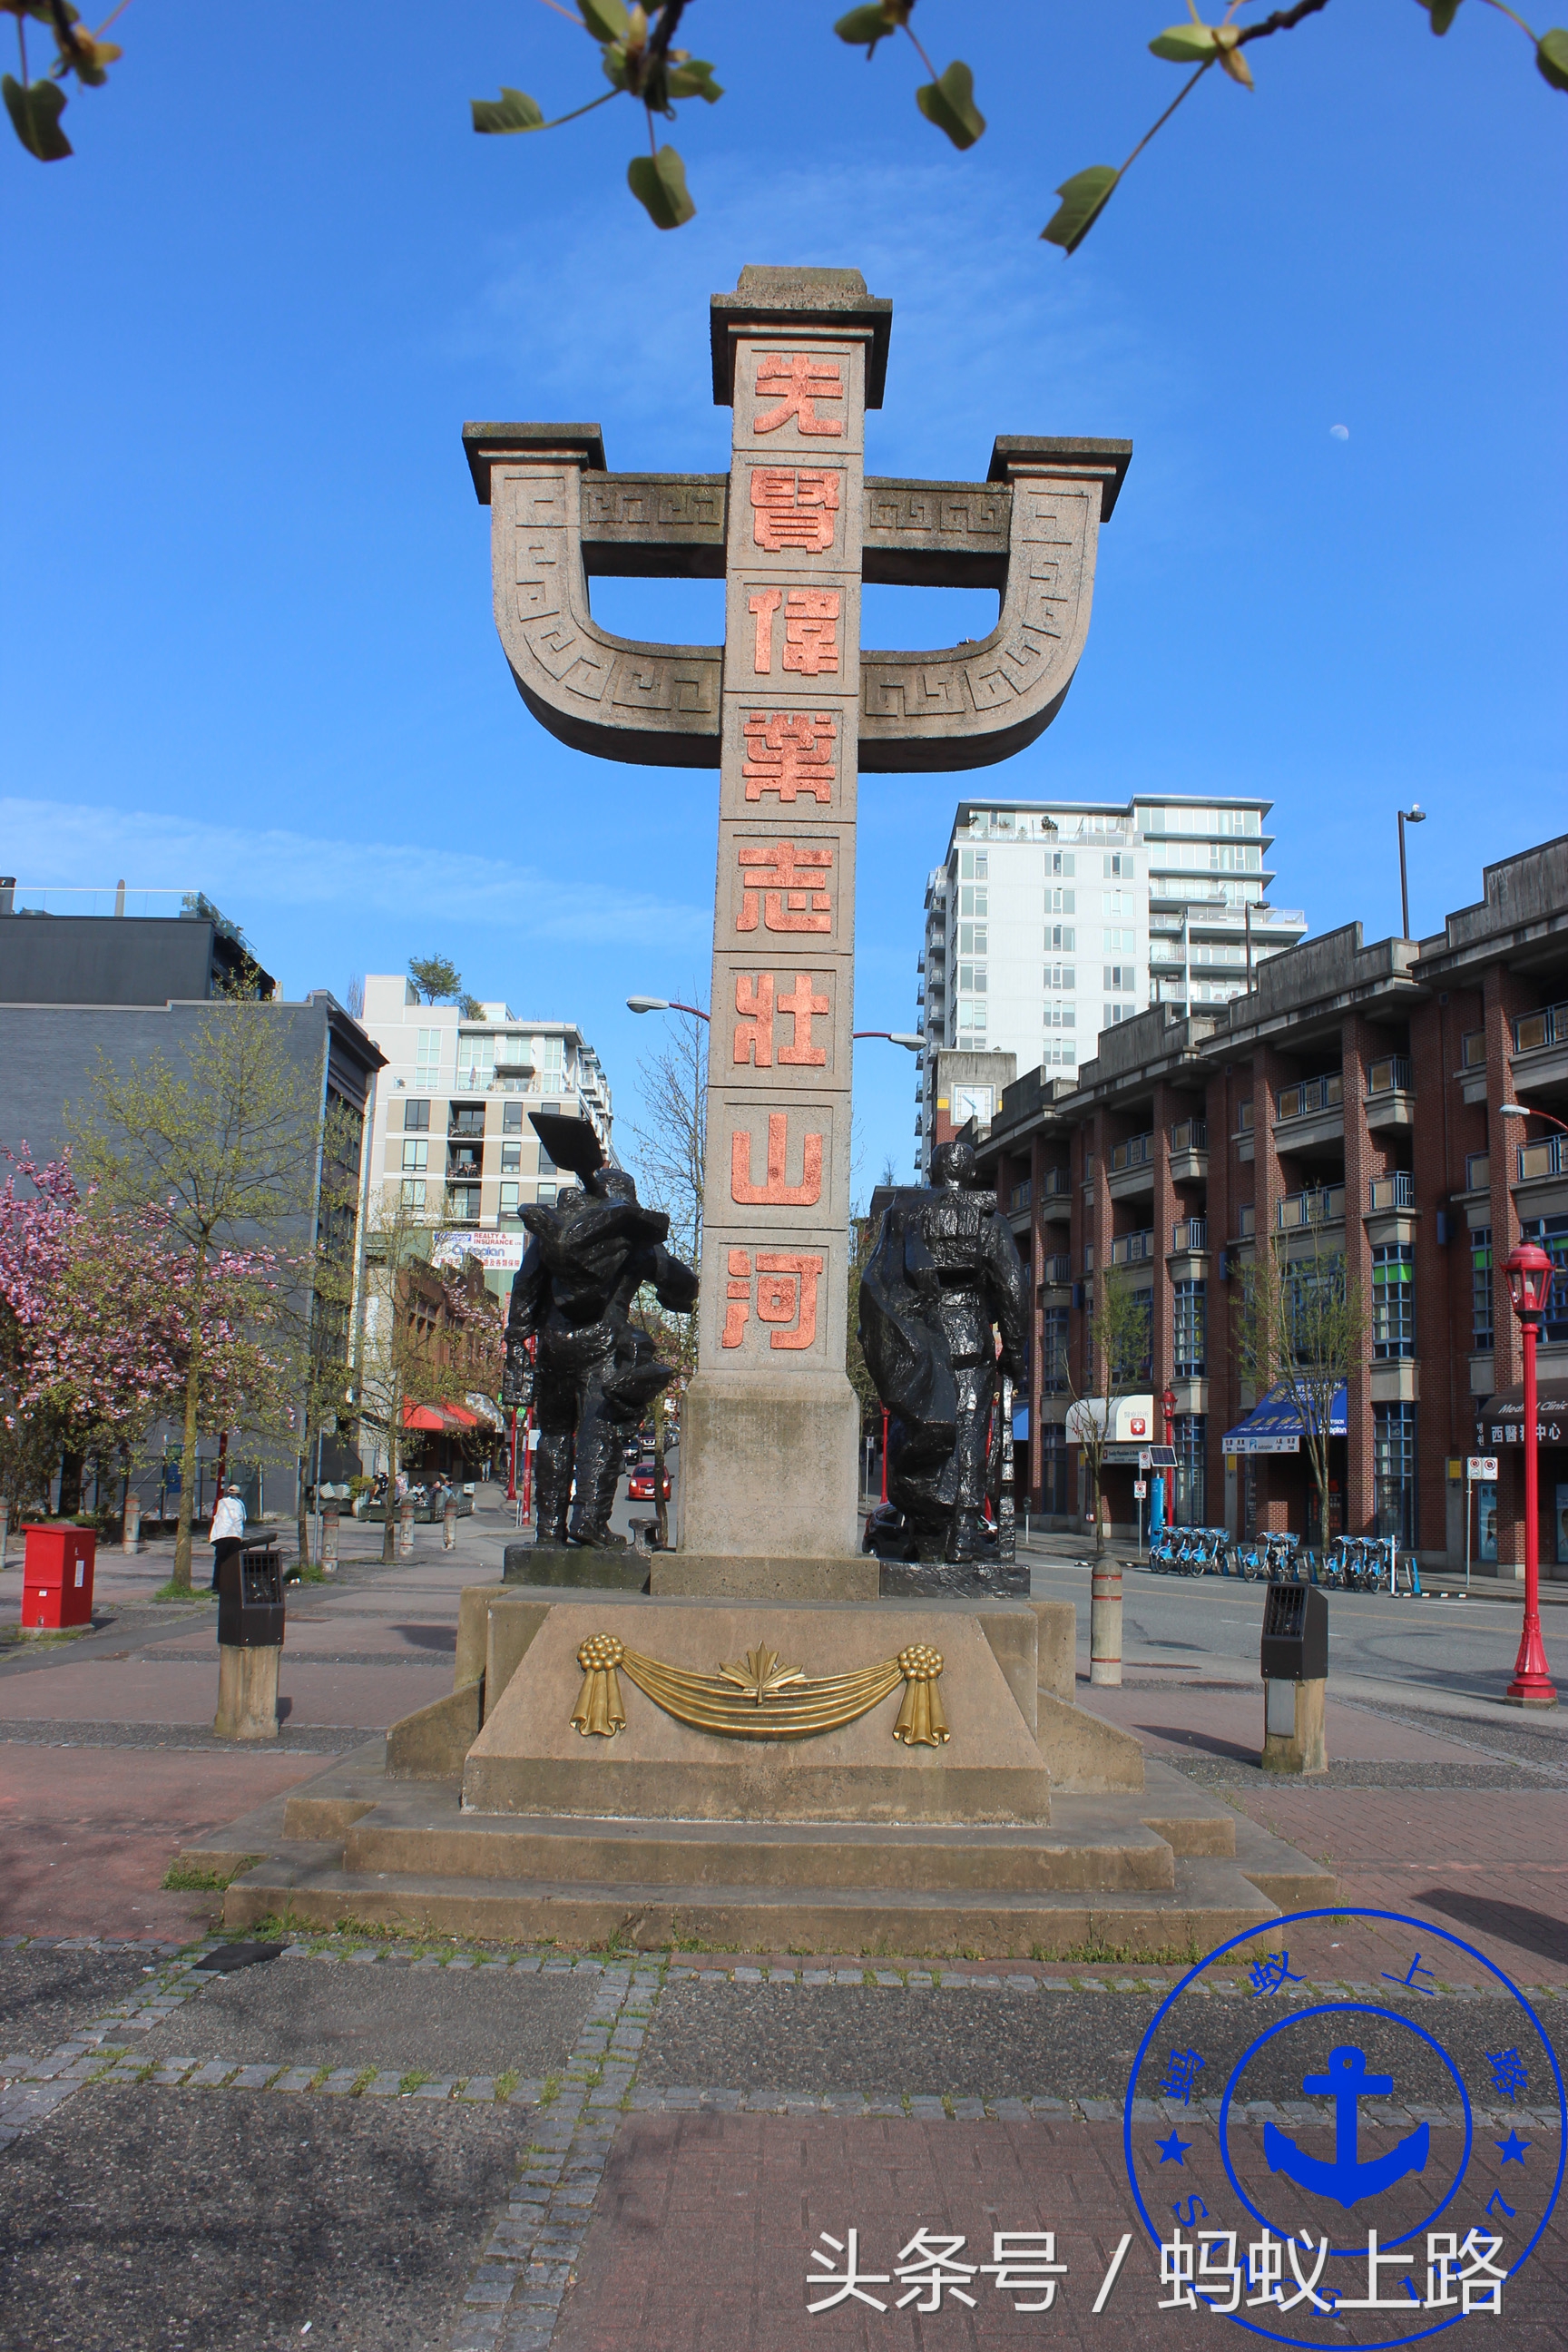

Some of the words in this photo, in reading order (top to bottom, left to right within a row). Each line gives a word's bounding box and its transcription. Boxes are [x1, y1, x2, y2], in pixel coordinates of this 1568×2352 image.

[722, 355, 843, 1350] 先賢偉業志壯山河
[1540, 1400, 1568, 1411] Clinic
